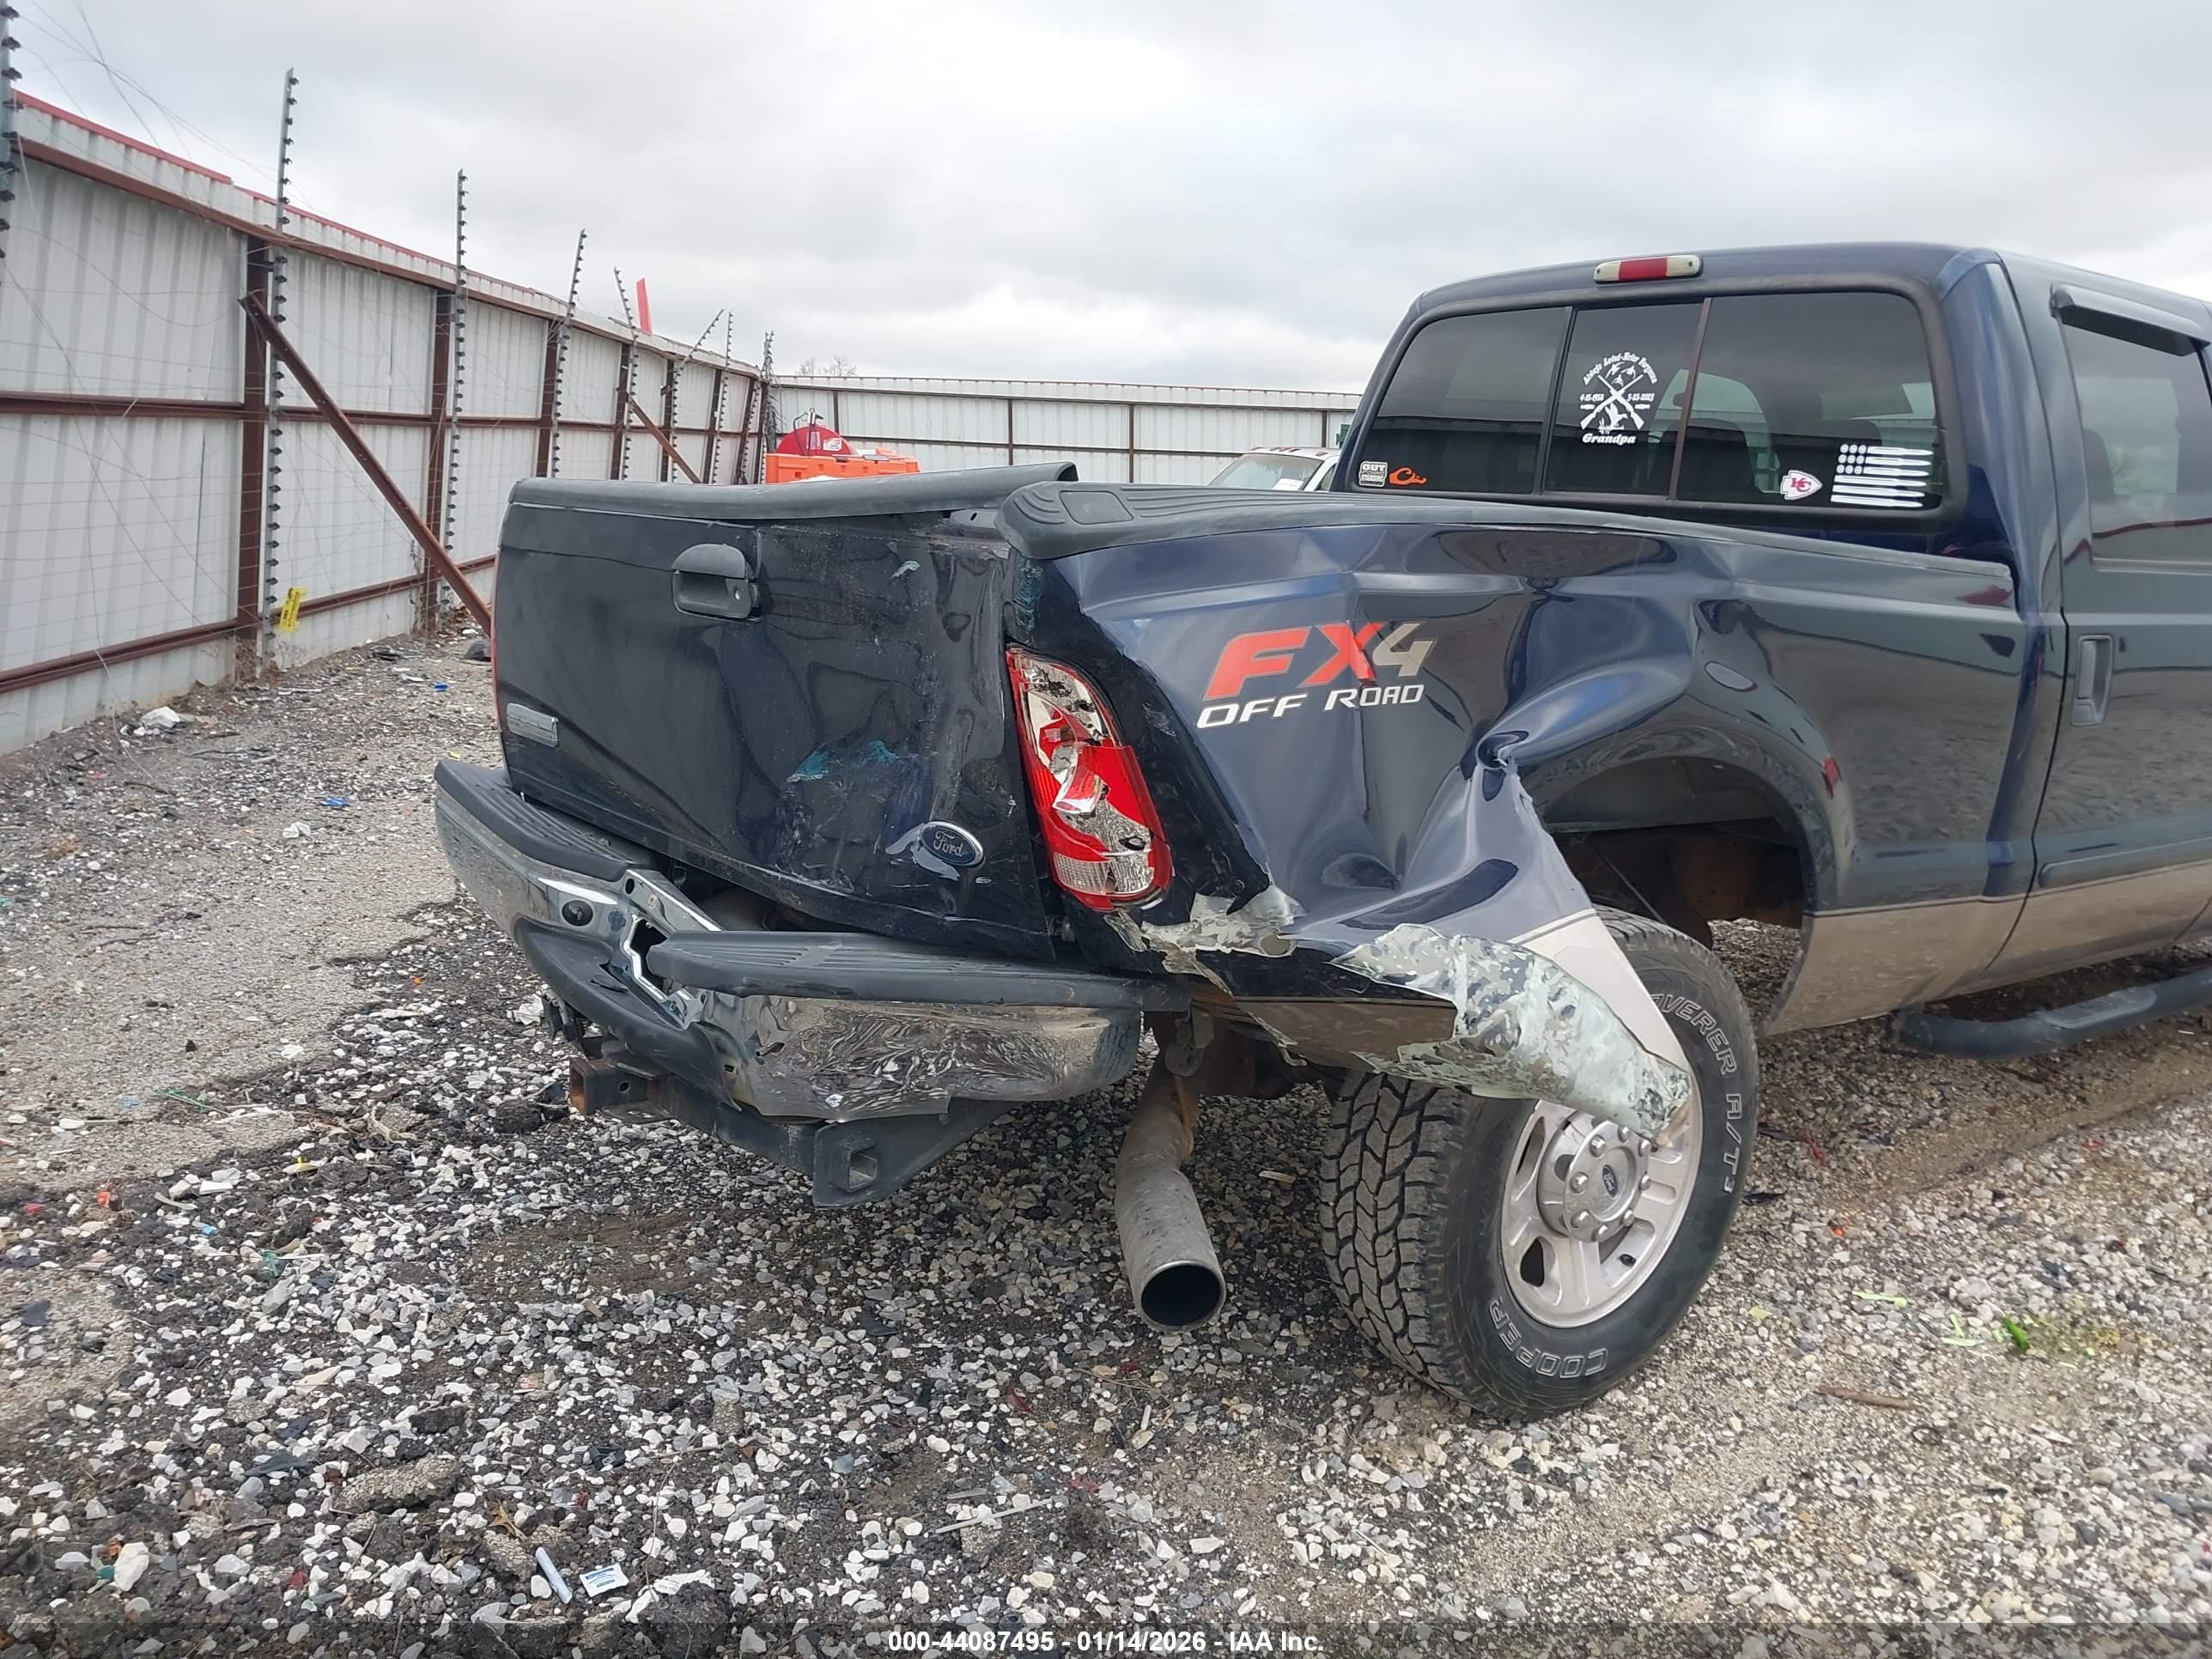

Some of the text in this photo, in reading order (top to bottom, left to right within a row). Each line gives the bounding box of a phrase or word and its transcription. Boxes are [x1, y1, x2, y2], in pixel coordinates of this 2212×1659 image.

[1582, 432, 1637, 446] Grandpa
[1202, 620, 1437, 702] FX4
[1196, 684, 1425, 729] OFF ROAD
[932, 830, 964, 858] Ford
[1488, 1297, 1608, 1379] COOPER
